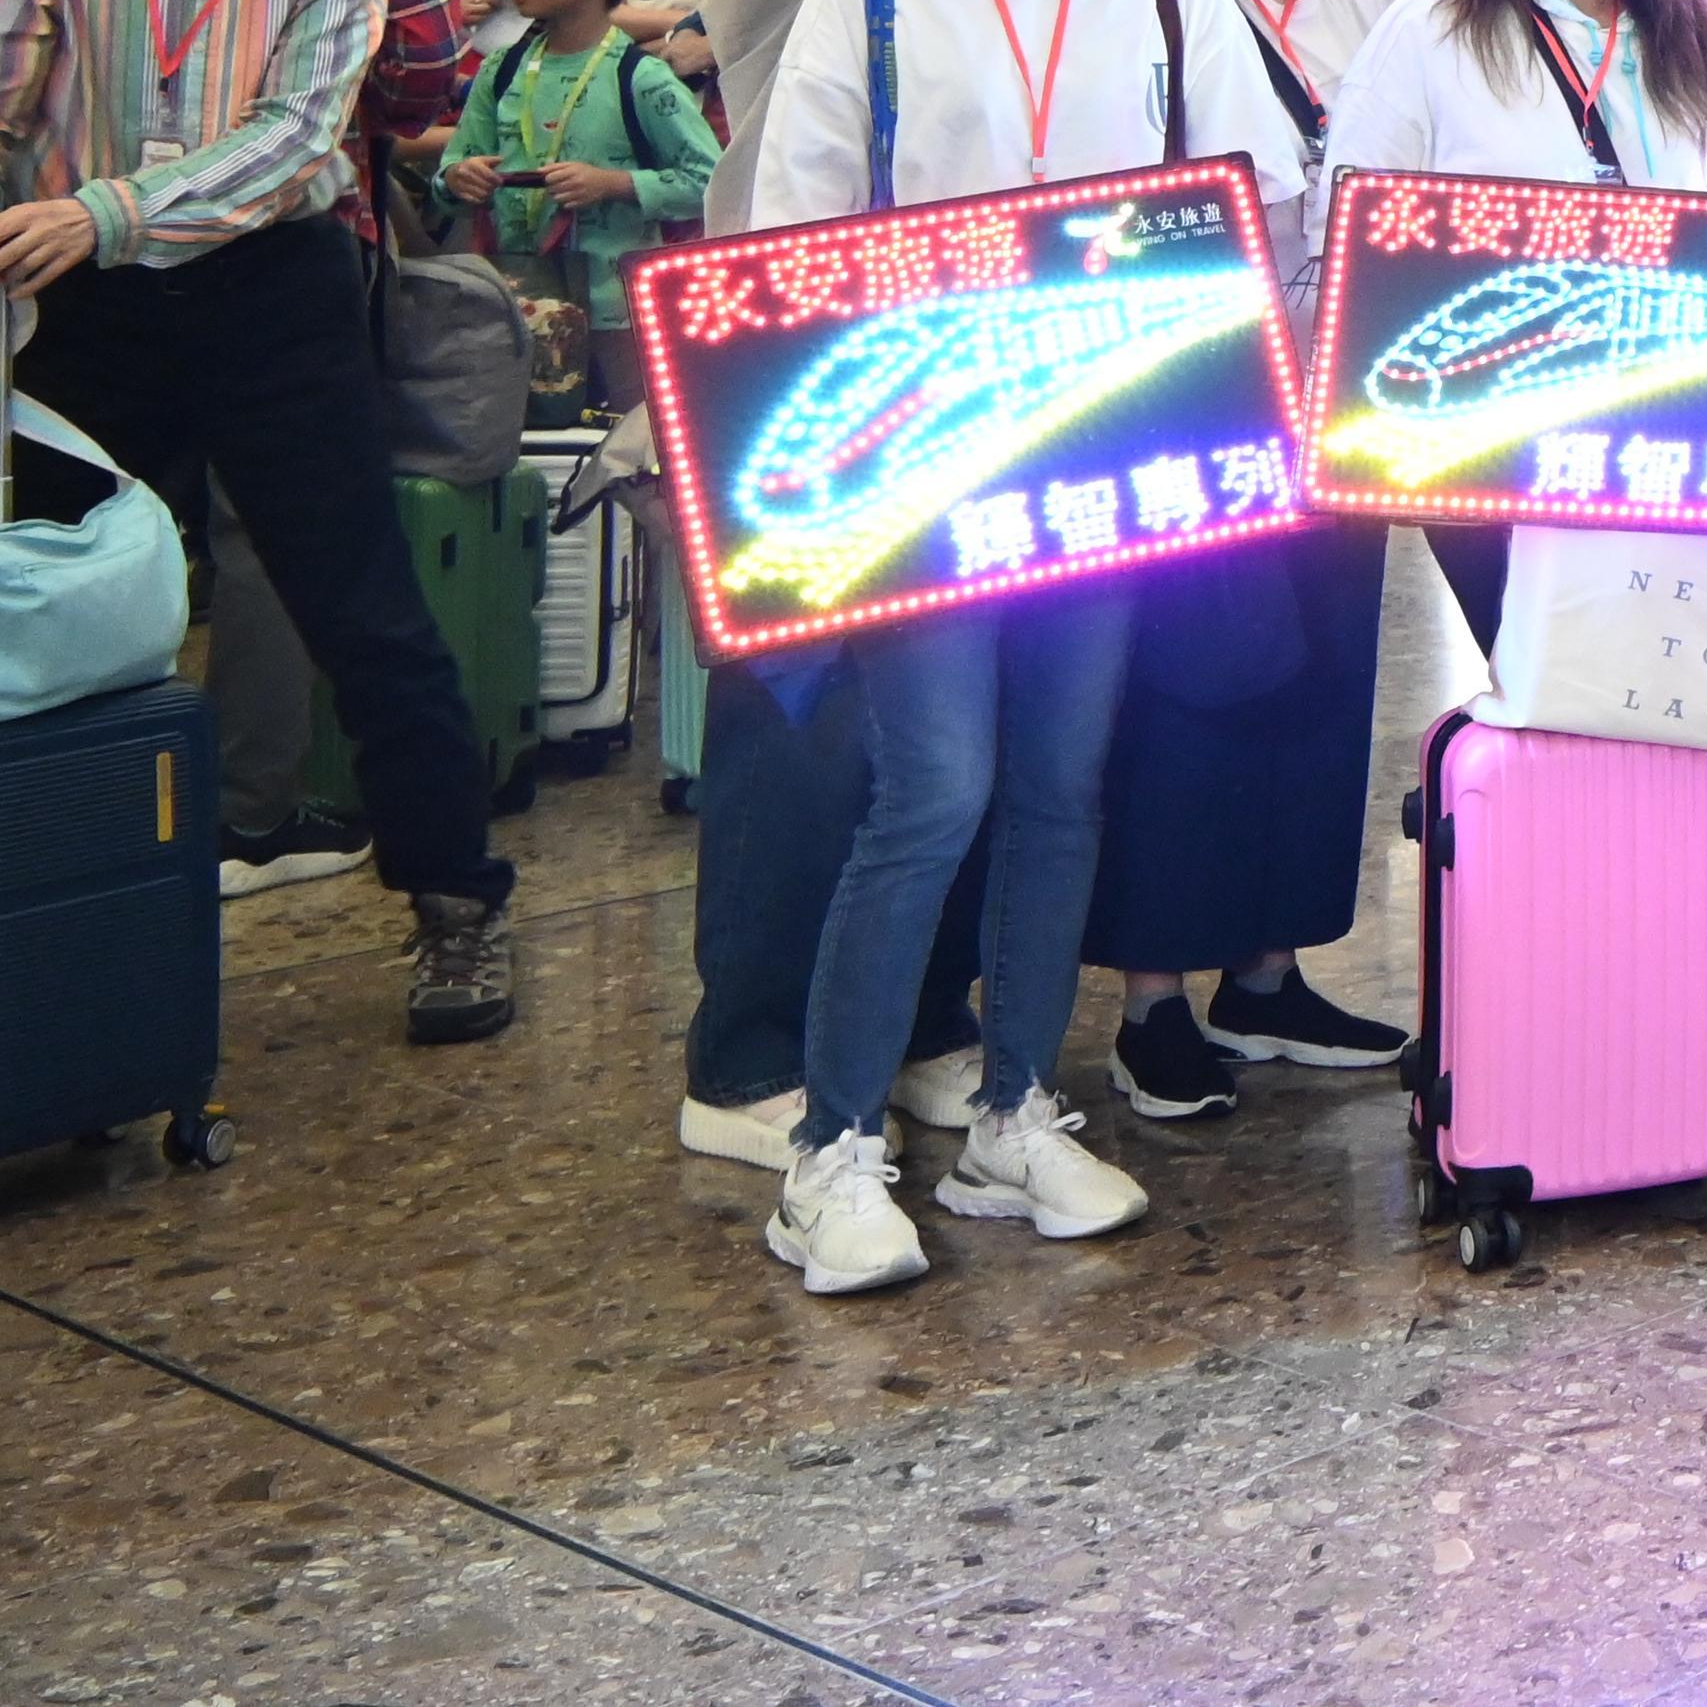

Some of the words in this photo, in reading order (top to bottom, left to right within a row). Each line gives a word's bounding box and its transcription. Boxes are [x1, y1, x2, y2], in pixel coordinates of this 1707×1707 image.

[1134, 202, 1224, 235] 永安旅遊
[1136, 234, 1167, 248] WING
[1170, 230, 1187, 242] ON
[1190, 223, 1226, 239] TRAVEL
[1366, 185, 1681, 268] 永安旅遊
[678, 214, 1032, 344] 永安旅遊
[946, 435, 1293, 579] 輝智專列
